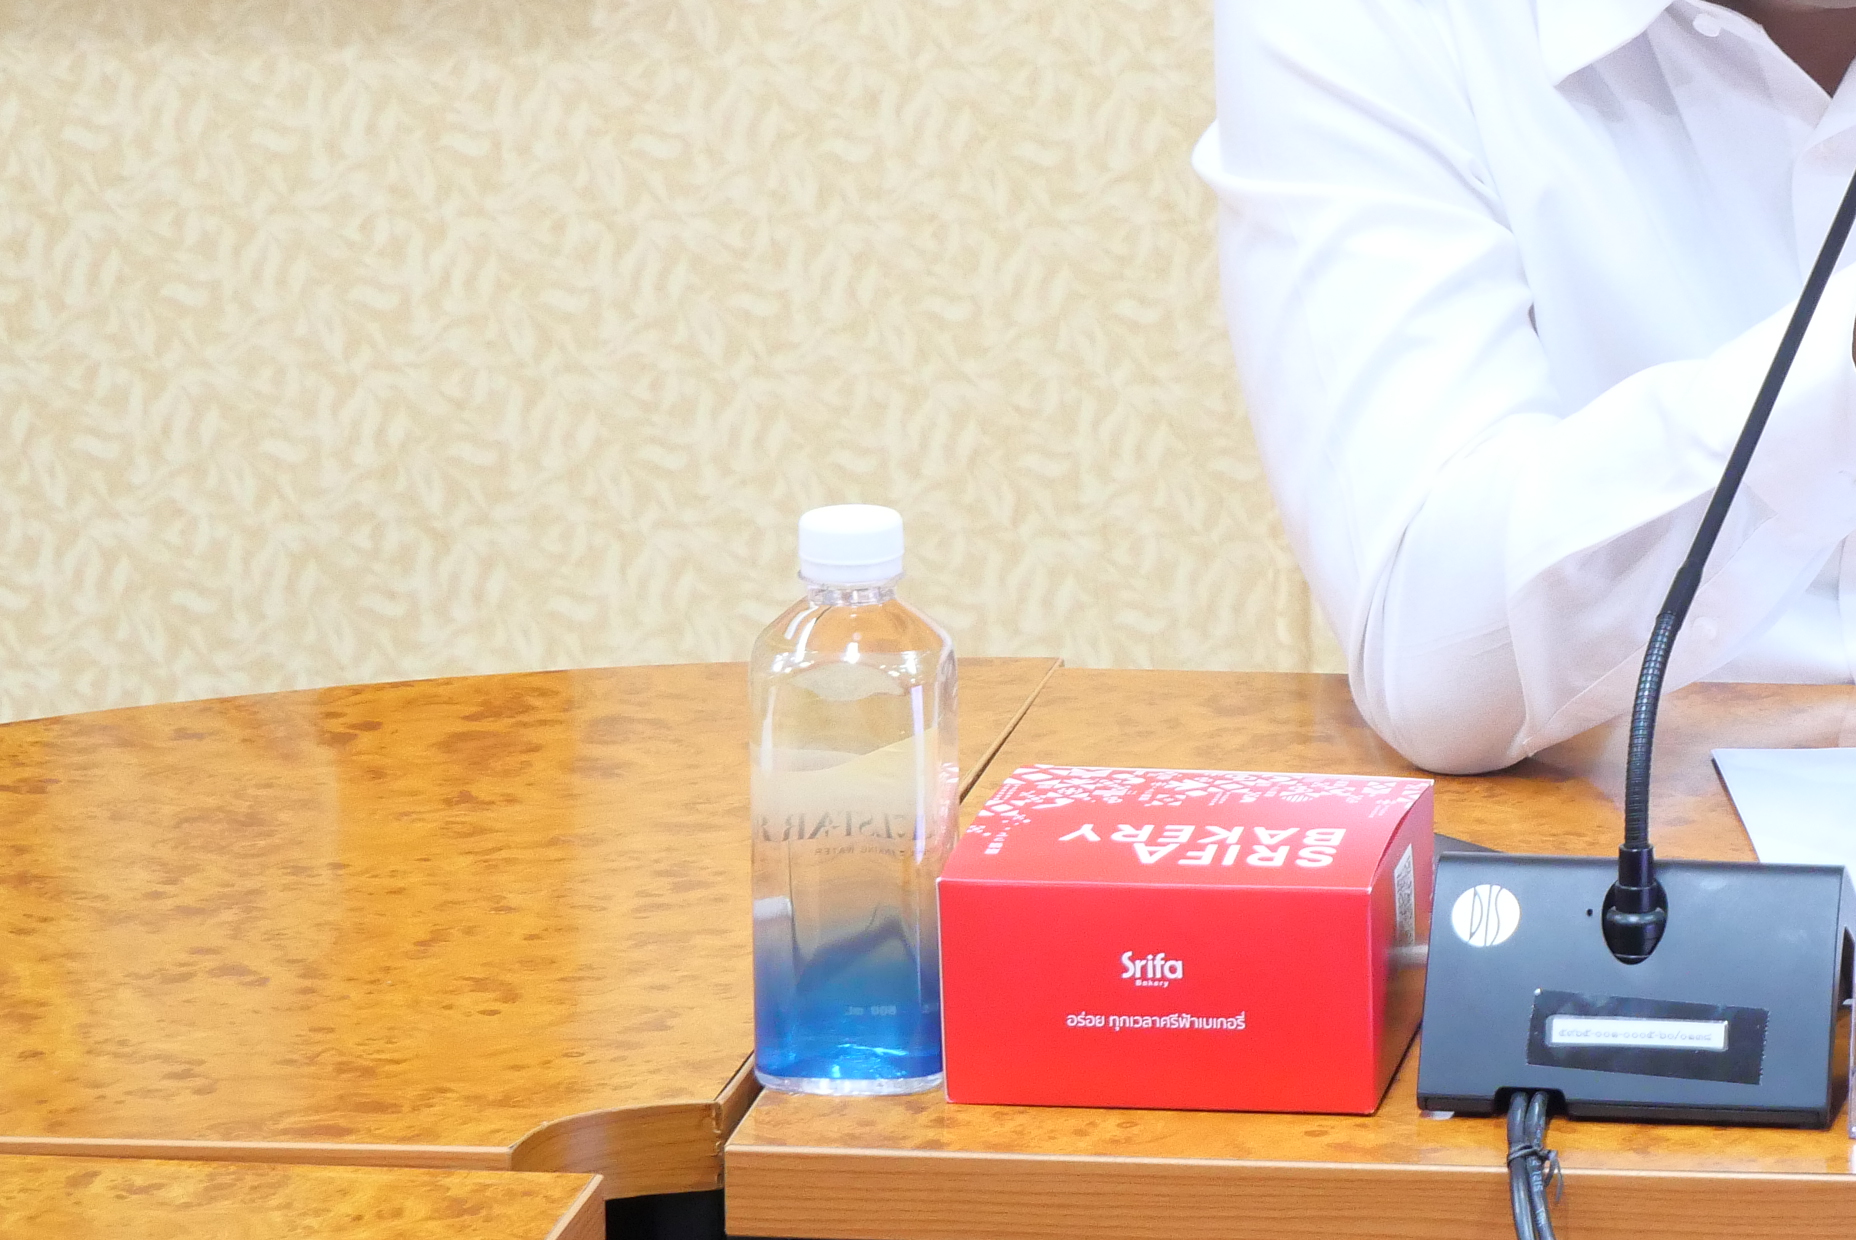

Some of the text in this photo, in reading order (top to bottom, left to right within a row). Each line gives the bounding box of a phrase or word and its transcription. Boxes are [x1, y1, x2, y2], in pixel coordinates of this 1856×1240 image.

[1058, 823, 1347, 846] BAKERY
[1132, 843, 1338, 867] SRIFA
[1120, 950, 1184, 980] Srifa
[1134, 979, 1170, 988] Bakery
[1066, 1010, 1247, 1032] อร่อย ทุกเวลาศรีฟ้าเบเกอรี่
